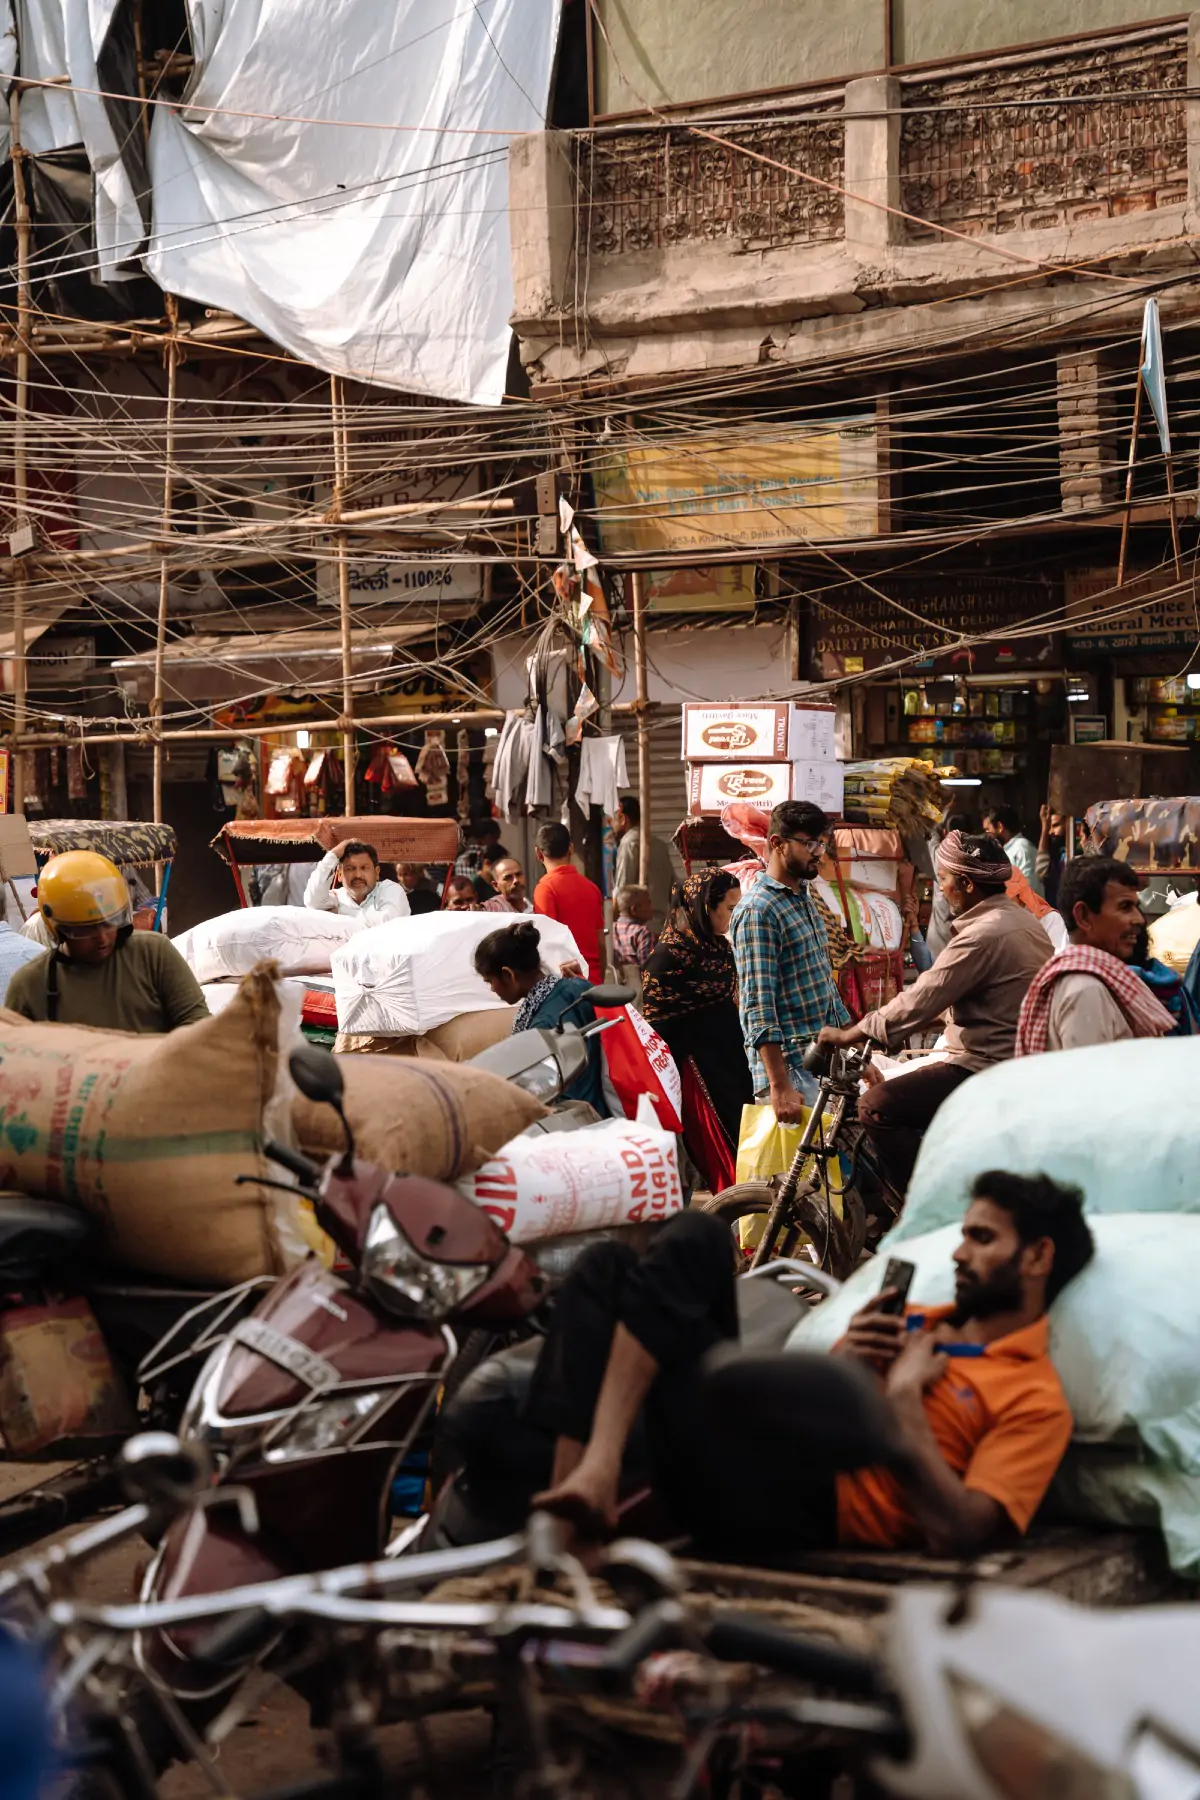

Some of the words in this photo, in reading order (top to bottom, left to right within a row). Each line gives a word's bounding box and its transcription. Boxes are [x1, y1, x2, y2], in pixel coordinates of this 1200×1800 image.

[817, 636, 859, 653] DAIRY
[862, 631, 940, 651] PRODUCTS
[777, 717, 786, 751] TRIVENI
[692, 769, 700, 804] TRIVENI
